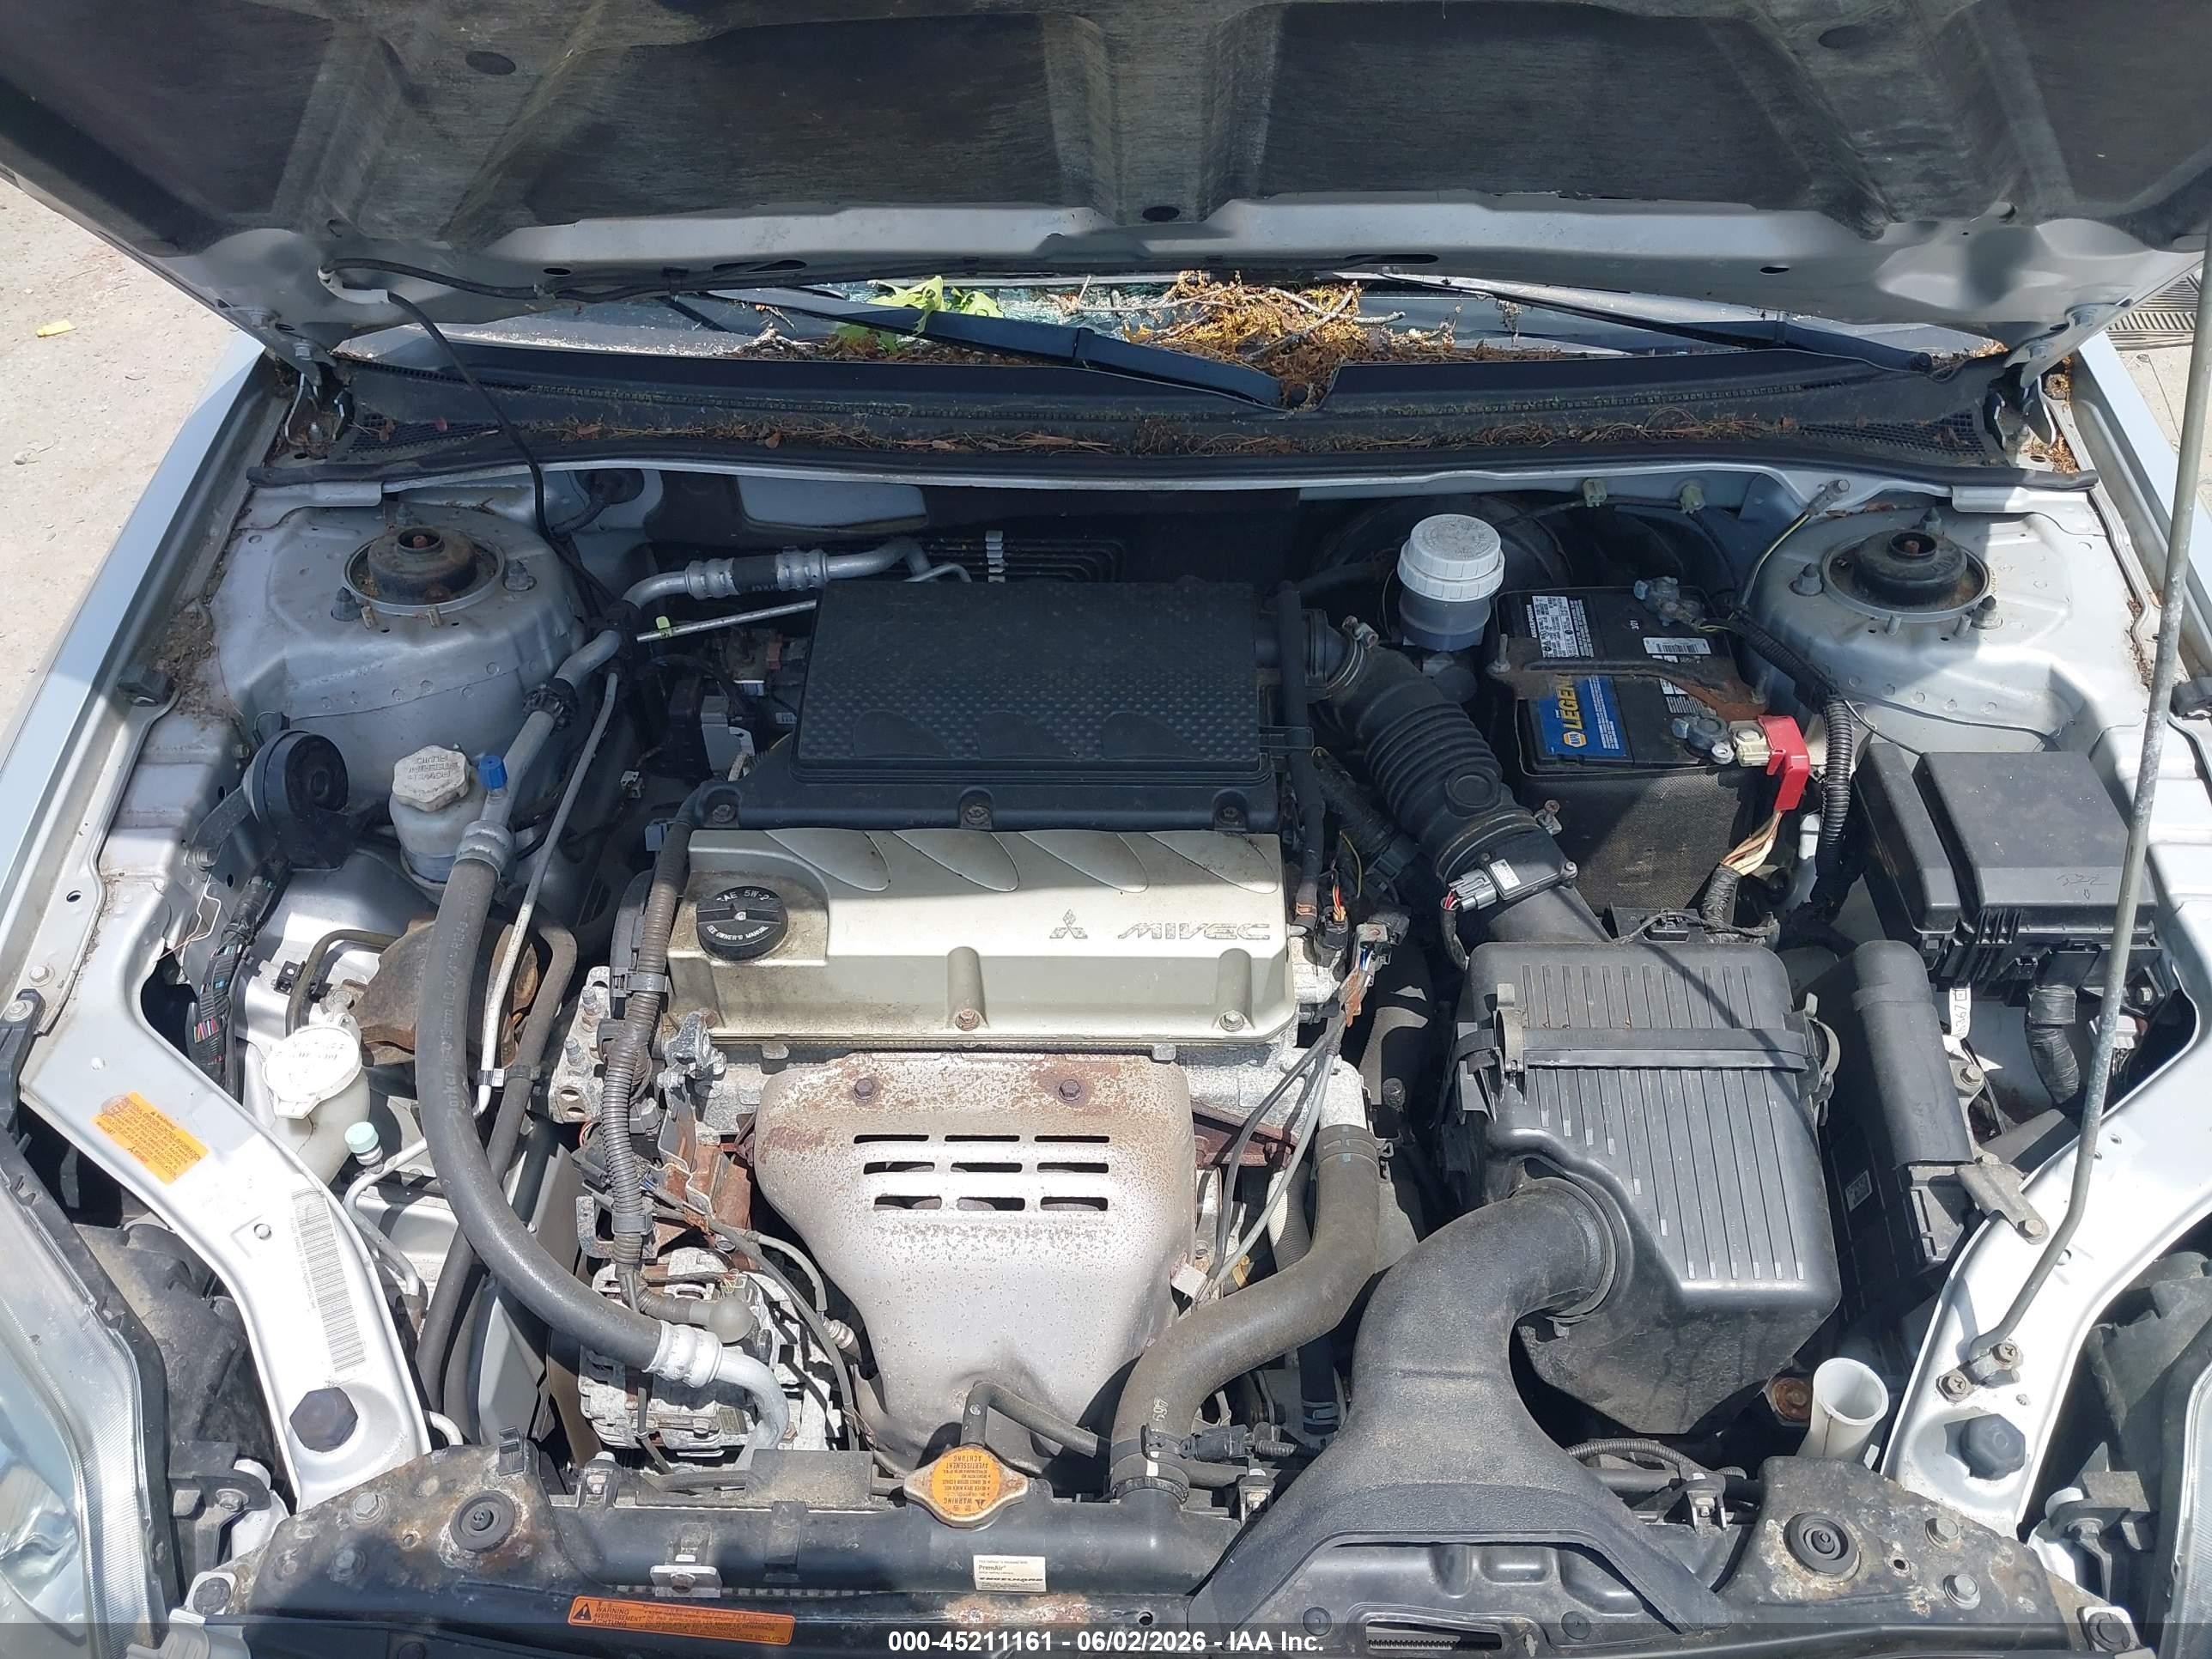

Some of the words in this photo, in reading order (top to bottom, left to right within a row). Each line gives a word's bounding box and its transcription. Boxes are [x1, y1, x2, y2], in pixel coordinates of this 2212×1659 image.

[1555, 674, 1583, 730] LEGEN
[707, 924, 719, 935] SEE
[715, 930, 744, 941] OWNER'S
[745, 926, 770, 939] MANUAL
[1117, 922, 1270, 939] MIVEC
[594, 1613, 642, 1622] AVERTISSEMENT
[596, 1607, 630, 1615] WARNING
[592, 1619, 628, 1627] ACHTUNG
